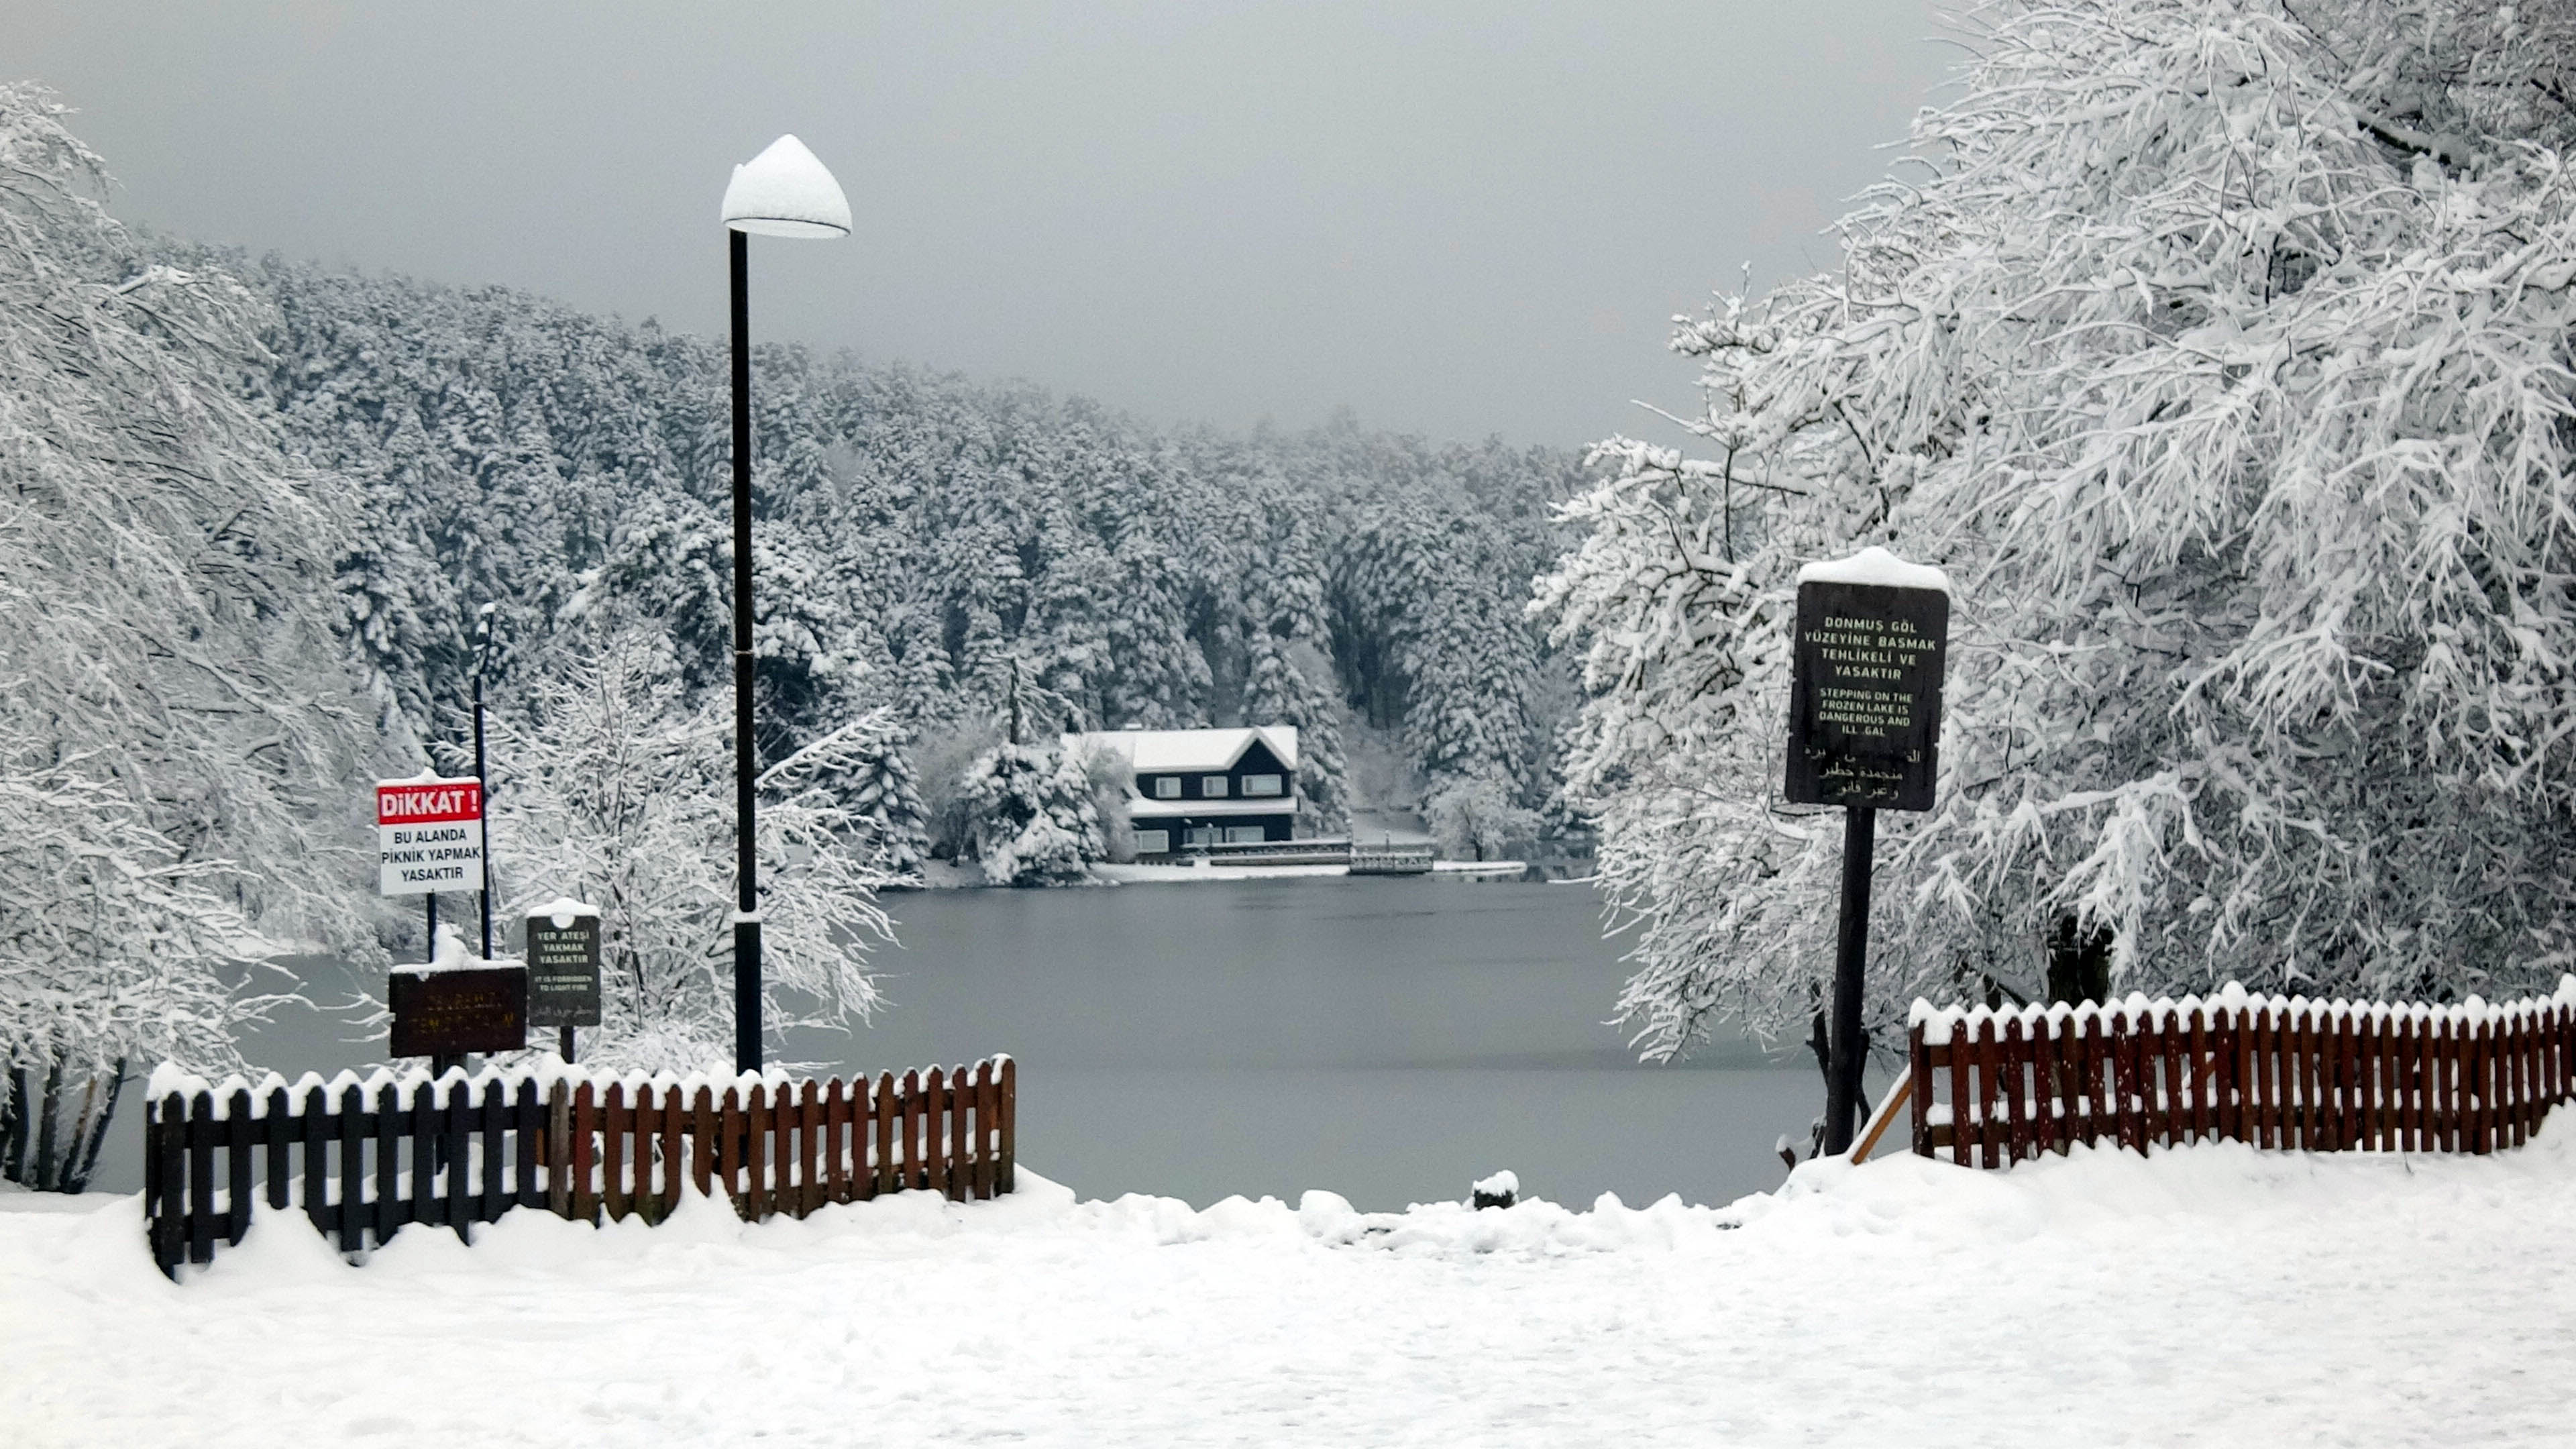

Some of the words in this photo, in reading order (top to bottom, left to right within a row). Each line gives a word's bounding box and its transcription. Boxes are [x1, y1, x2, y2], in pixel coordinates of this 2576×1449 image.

[1825, 616, 1884, 633] DONMUŞ
[1891, 619, 1917, 633] GÖL
[1805, 629, 1871, 646] YÜZEYİNE
[1878, 636, 1936, 651] BASMAK
[1821, 647, 1892, 663] TEHLİKELİ
[1899, 653, 1917, 665] VE
[1835, 665, 1902, 680] YASAKTIR
[1819, 688, 1872, 700] STEPPING
[1874, 692, 1890, 702] ON
[1893, 692, 1913, 703] THE
[1822, 700, 1864, 711] FROZEN
[1867, 702, 1894, 714] LAKE
[1898, 704, 1909, 715] IS
[1819, 711, 1884, 724] DANGEROUS
[1887, 716, 1910, 727] AND
[1841, 724, 1886, 737] ILLGAL
[394, 832, 411, 843] BU
[416, 828, 467, 843] ALANDA
[382, 847, 425, 864] PİKNİK
[429, 847, 480, 861] YAPMAK
[401, 867, 464, 881] YASAKTIR
[537, 931, 557, 941] YER
[543, 943, 585, 952] YAKMAK
[539, 955, 588, 964] YASAKTIR
